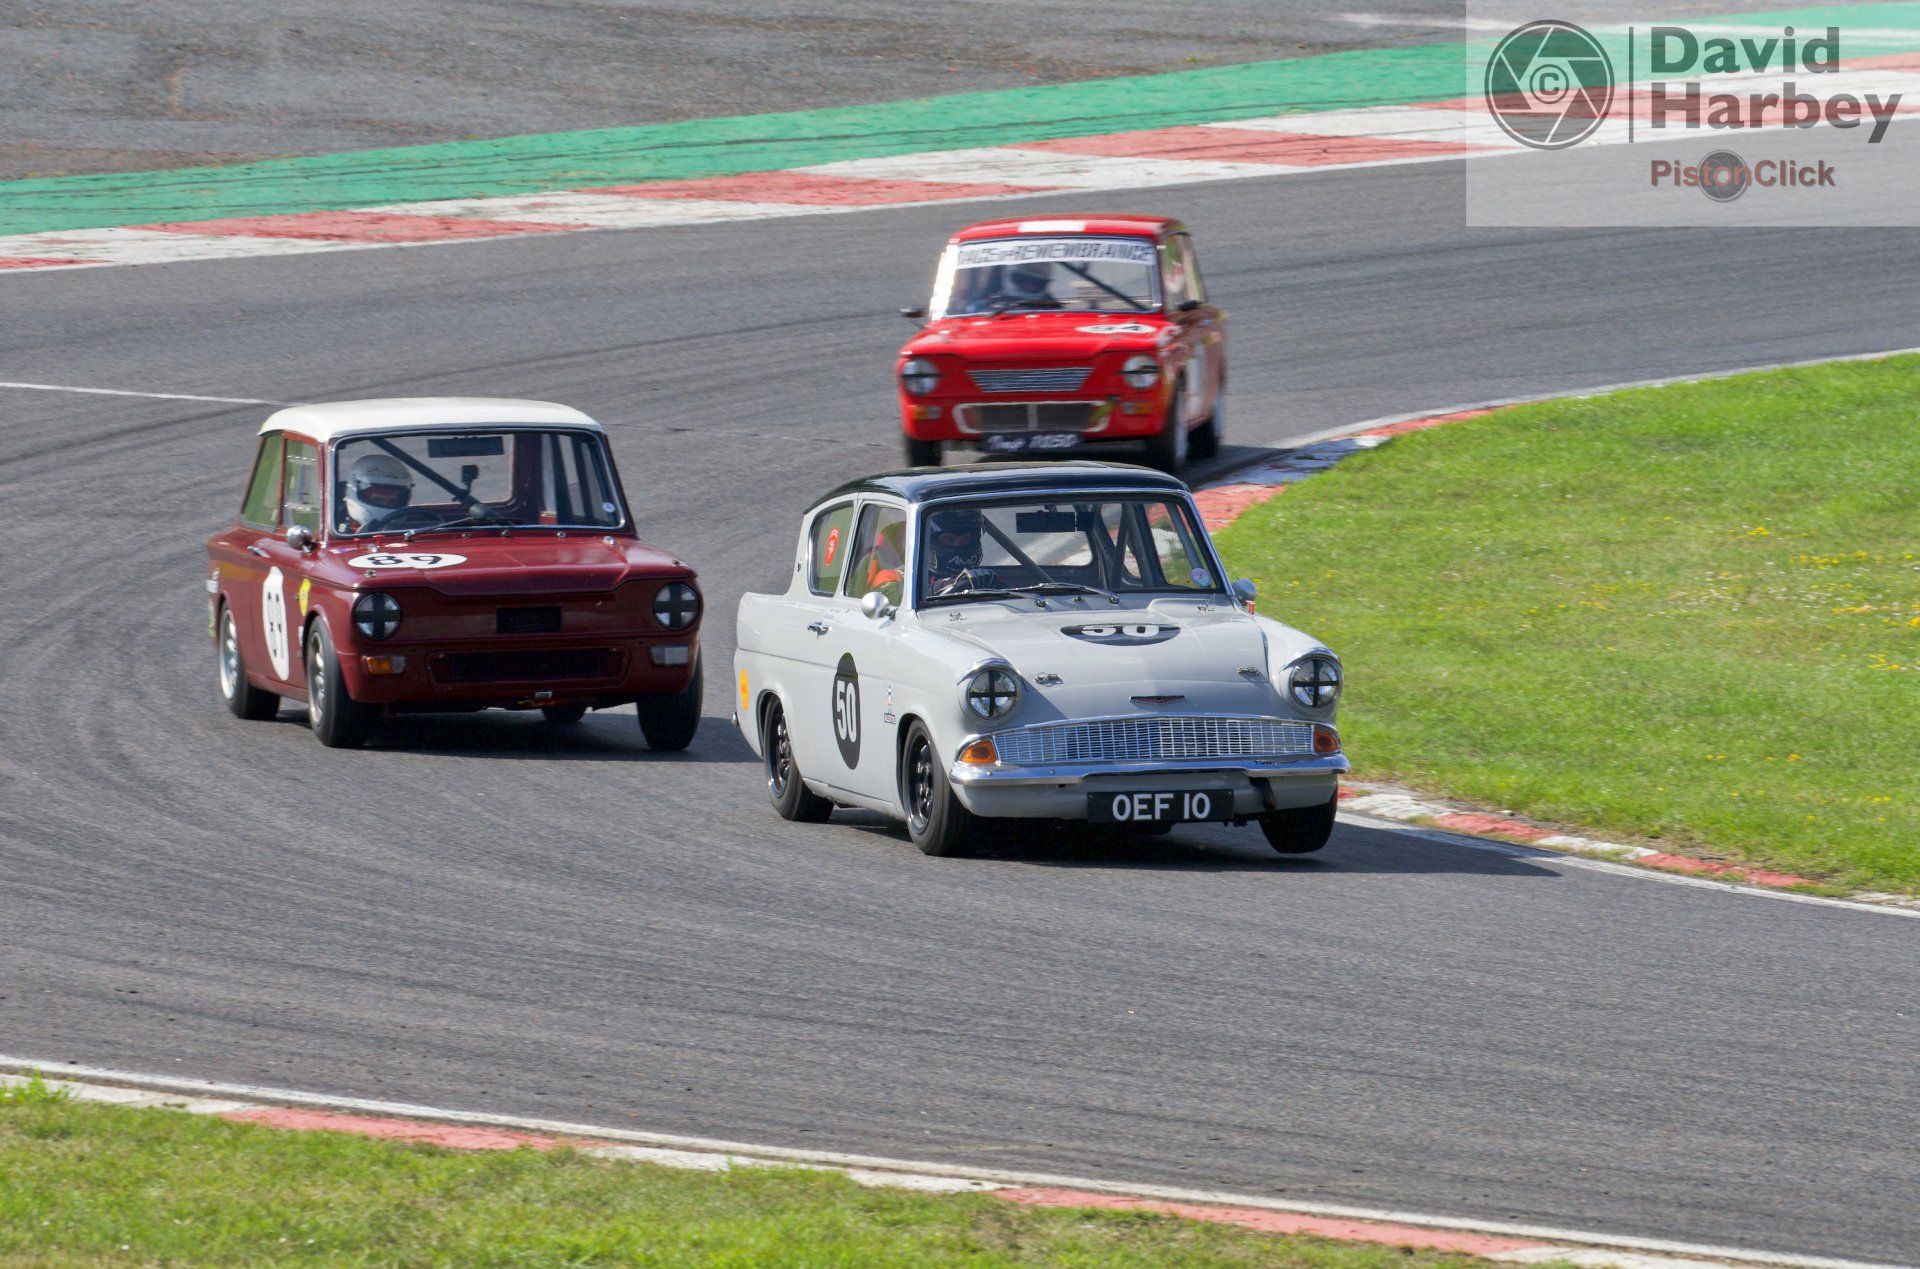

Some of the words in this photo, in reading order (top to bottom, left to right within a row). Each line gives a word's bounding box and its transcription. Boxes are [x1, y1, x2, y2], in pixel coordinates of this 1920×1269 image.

[366, 555, 443, 566] 89
[1081, 623, 1160, 637] 50
[837, 680, 857, 743] 50
[1111, 792, 1176, 821] OEF
[1182, 791, 1212, 820] 10
